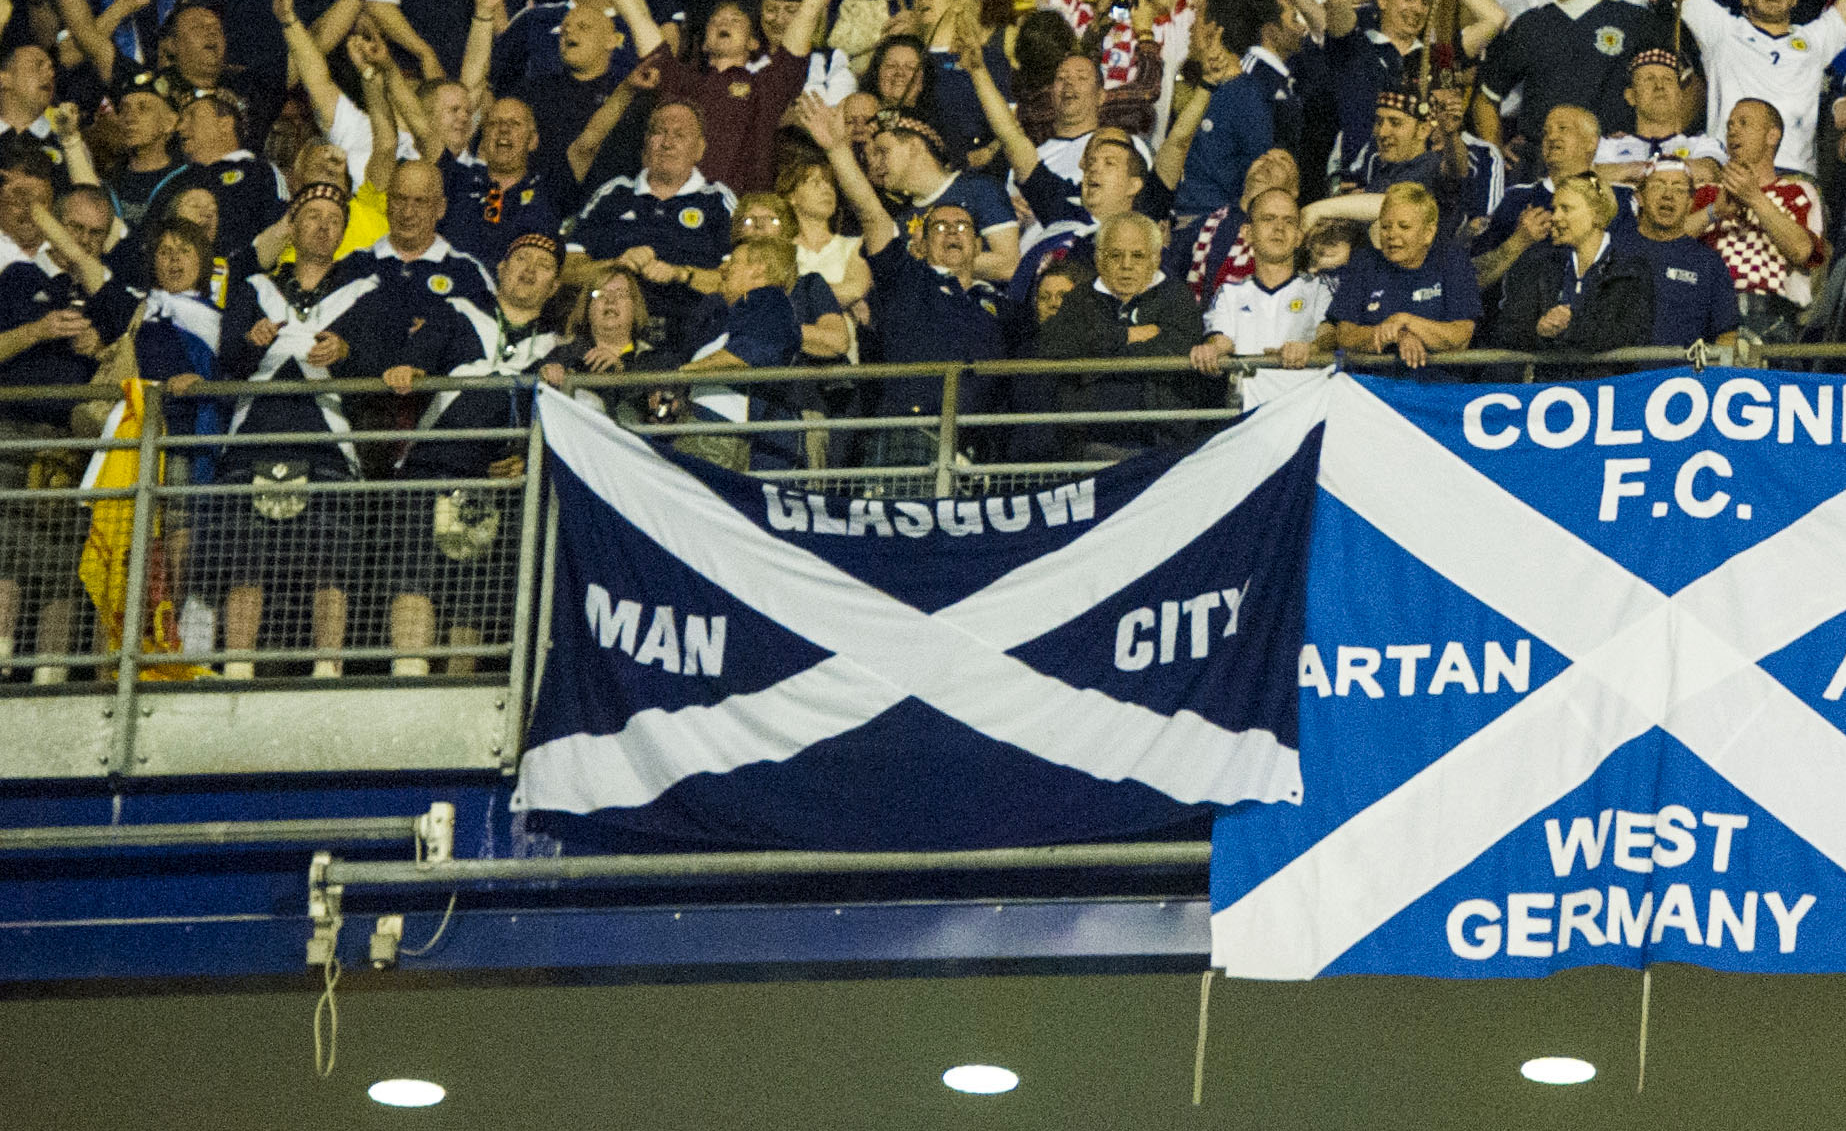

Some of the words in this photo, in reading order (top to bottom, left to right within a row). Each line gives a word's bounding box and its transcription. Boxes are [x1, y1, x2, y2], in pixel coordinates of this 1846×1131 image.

[762, 477, 1096, 538] GLASGOW
[1599, 450, 1753, 521] F.C.
[584, 582, 728, 678] MAN
[1113, 578, 1251, 672] CITY
[1545, 804, 1749, 878] WEST
[1445, 883, 1817, 960] GERMANY
